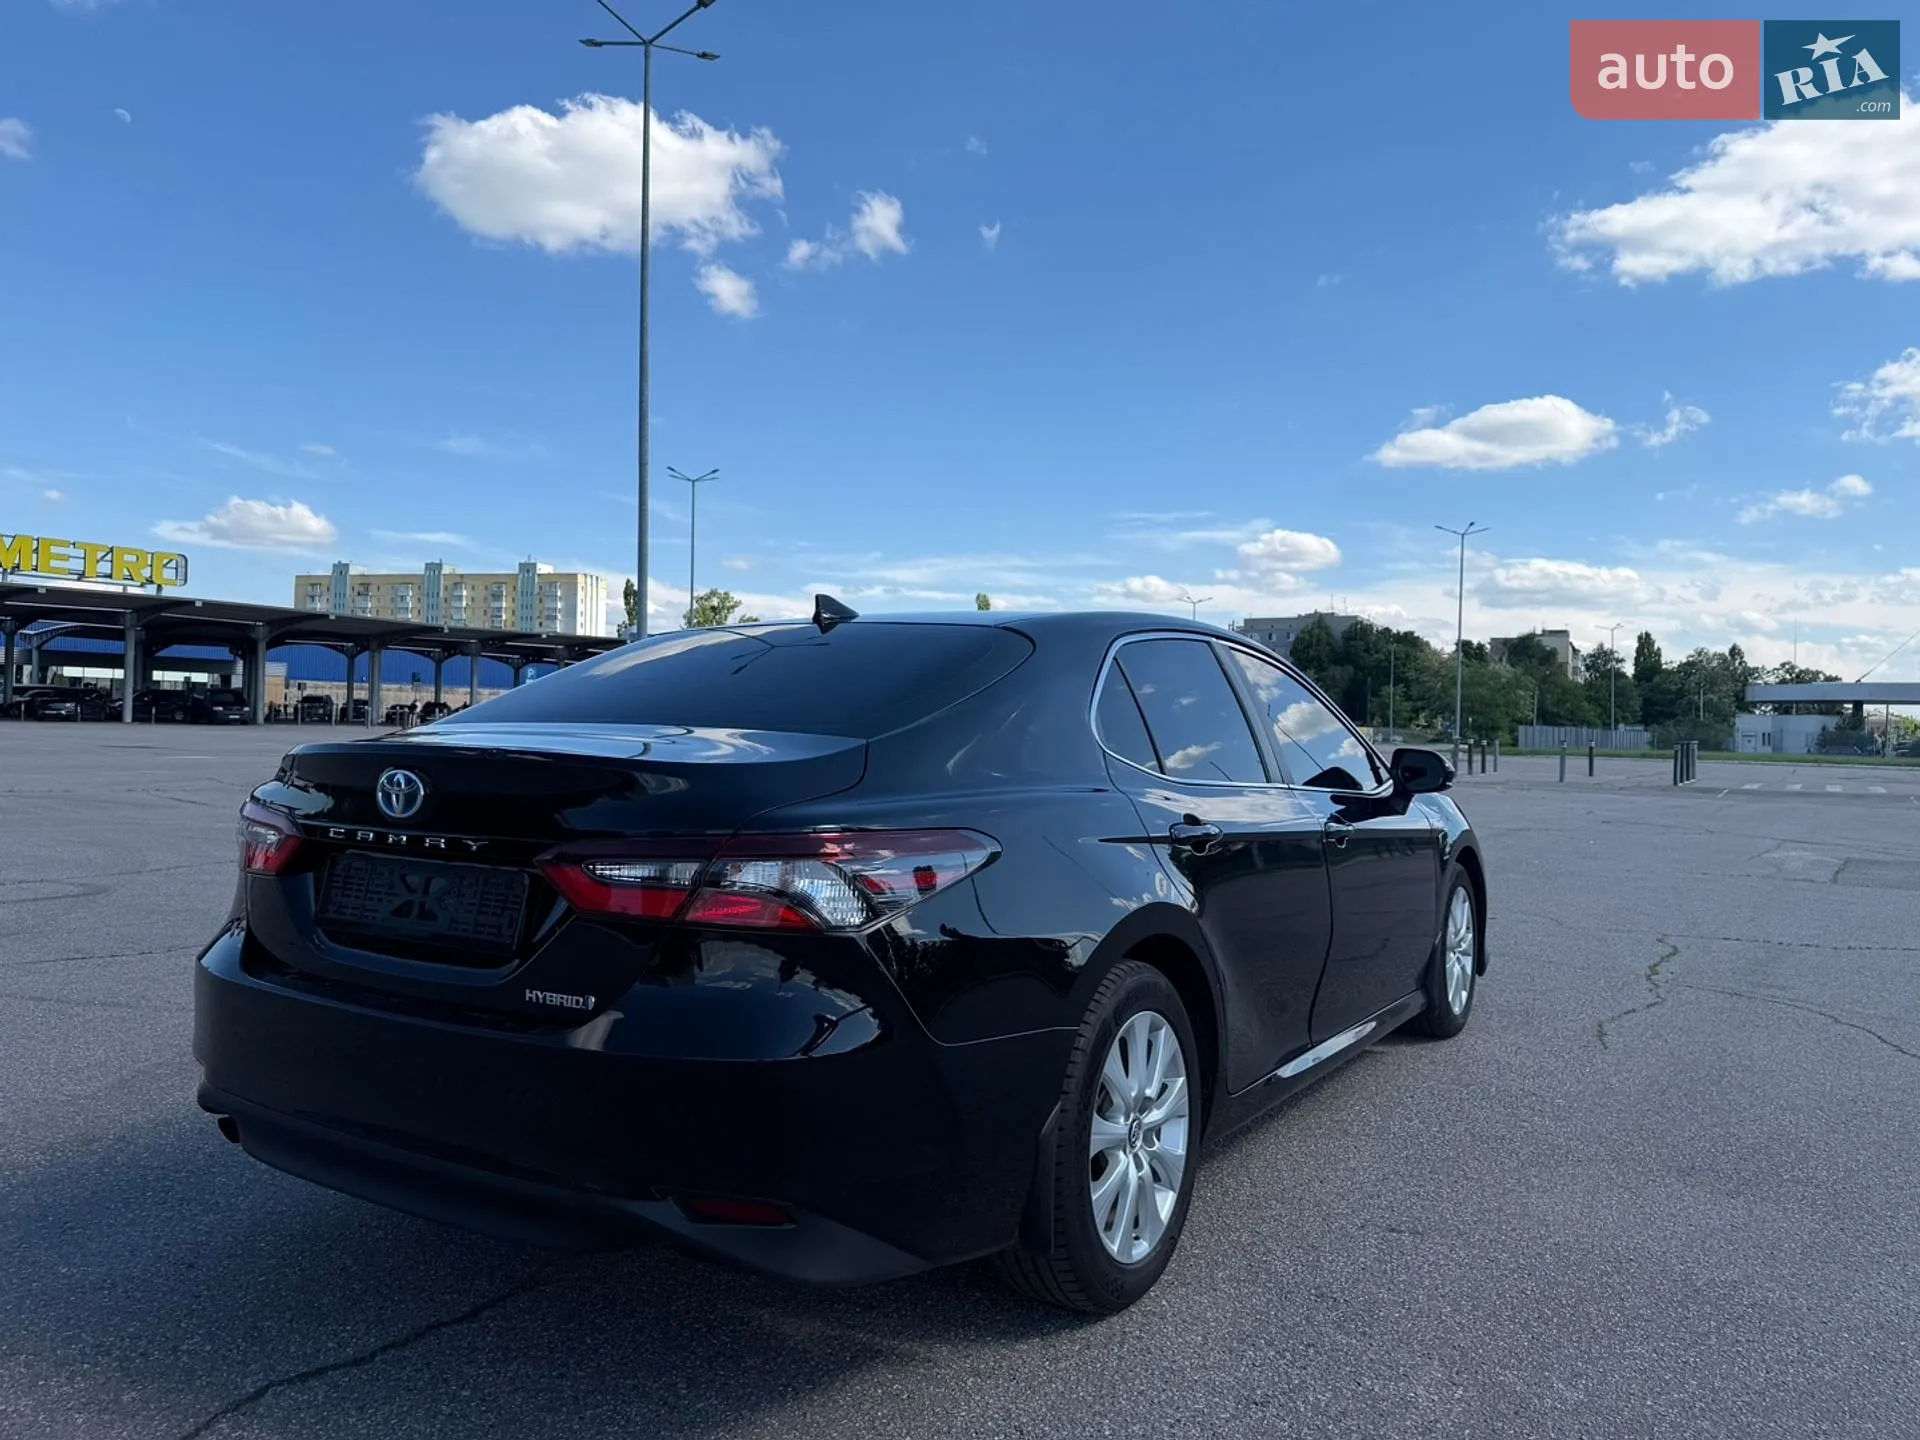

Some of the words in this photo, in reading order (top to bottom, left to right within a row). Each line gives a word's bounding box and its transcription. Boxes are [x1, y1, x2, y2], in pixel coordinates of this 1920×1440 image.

[0, 533, 188, 588] METRO
[329, 827, 488, 851] CAMRY
[525, 988, 585, 1009] HYBRID
